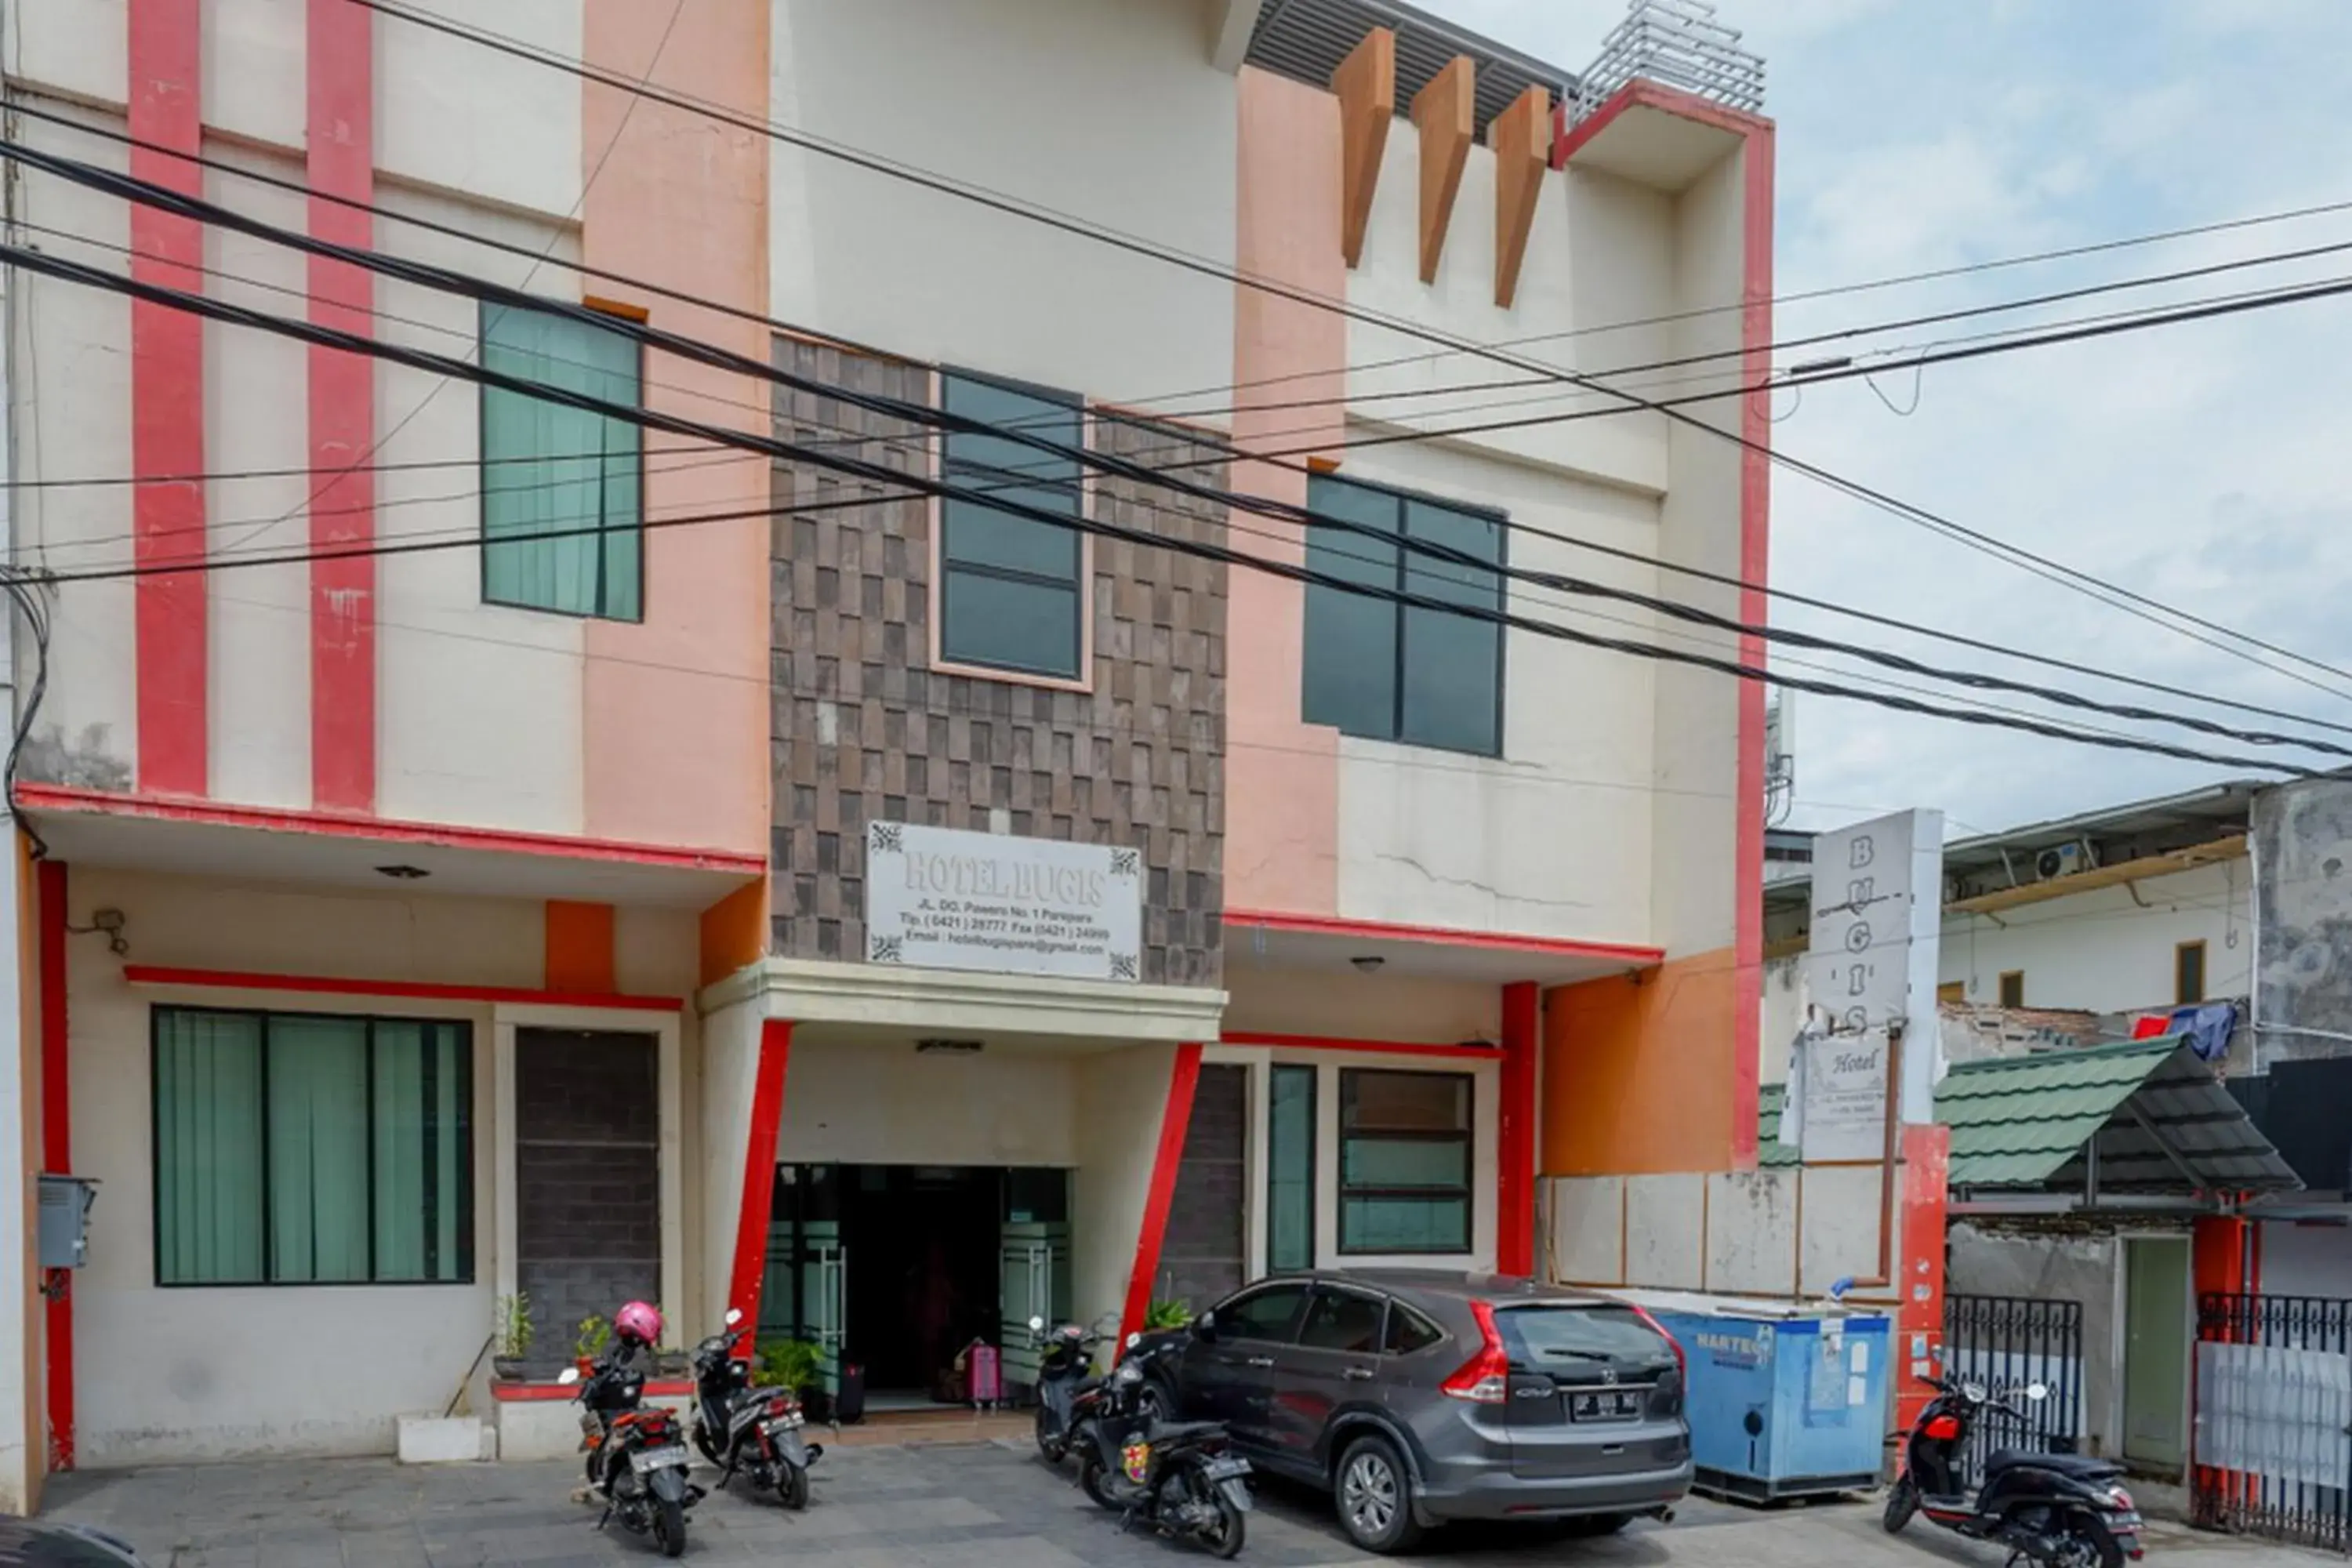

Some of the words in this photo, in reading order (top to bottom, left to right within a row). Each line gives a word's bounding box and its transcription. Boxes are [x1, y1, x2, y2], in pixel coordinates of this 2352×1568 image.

[904, 851, 1011, 898] HOTEL
[1014, 860, 1105, 908] BUGIS
[1831, 1048, 1878, 1075] Hotel
